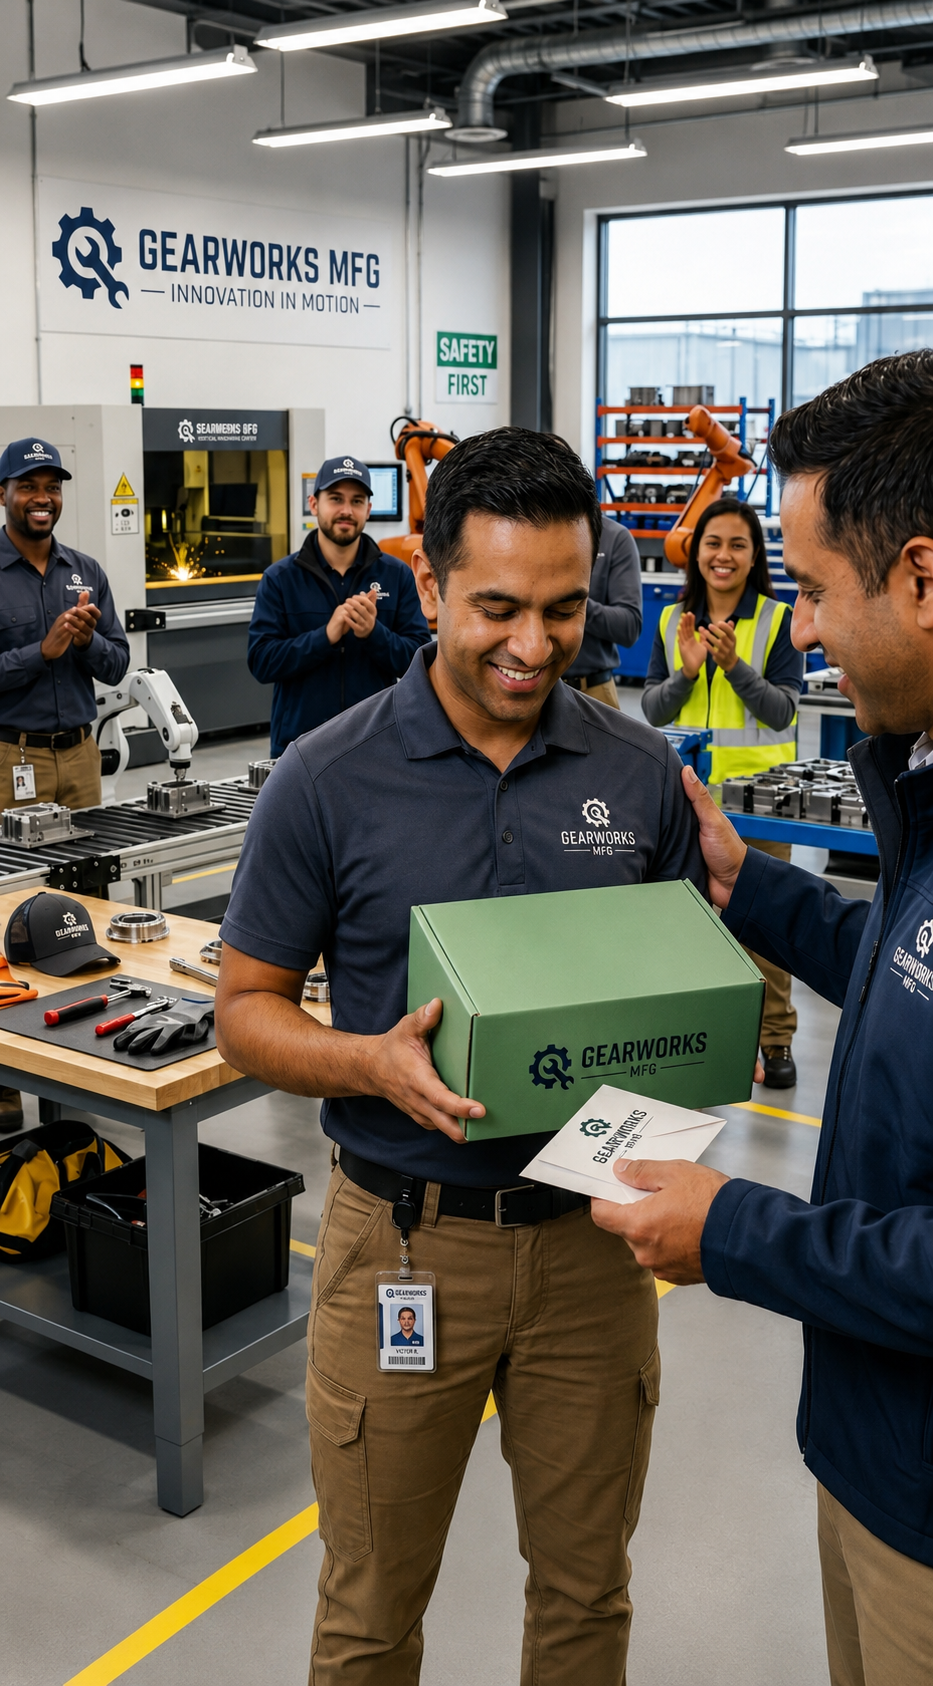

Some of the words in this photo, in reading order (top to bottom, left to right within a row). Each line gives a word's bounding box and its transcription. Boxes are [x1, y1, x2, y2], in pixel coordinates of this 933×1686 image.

[138, 228, 320, 284] GEARWORKS
[329, 248, 381, 289] MFG
[171, 283, 275, 309] INNOVATION
[281, 291, 297, 311] IN
[302, 293, 360, 314] MOTION
[439, 336, 496, 364] SAFETY
[448, 373, 487, 396] FIRST
[561, 830, 636, 846] GEARWORKS
[592, 846, 613, 856] MFG
[581, 1031, 708, 1069] GEARWORKS
[630, 1063, 657, 1078] MFG
